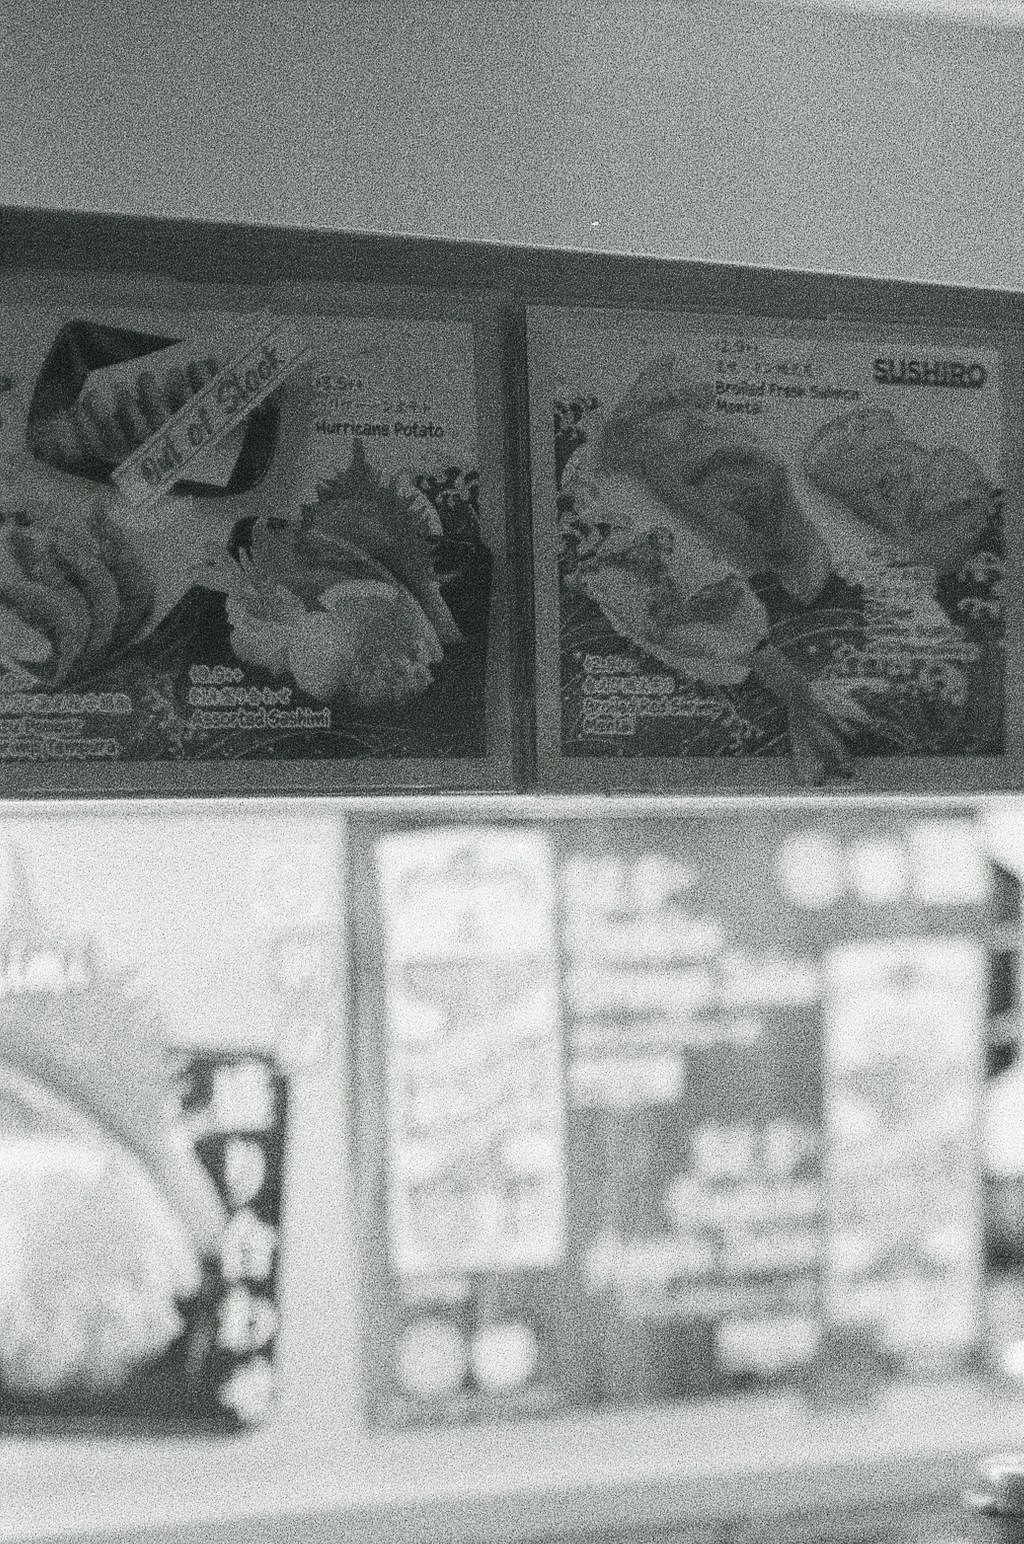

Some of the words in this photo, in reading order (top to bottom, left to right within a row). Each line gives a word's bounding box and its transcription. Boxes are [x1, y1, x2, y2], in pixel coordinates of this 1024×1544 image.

[216, 345, 285, 416] Stock
[873, 358, 987, 388] SUSHIRO
[315, 420, 390, 437] Hurricane
[393, 421, 445, 438] Potato
[192, 707, 266, 728] Assorted
[267, 706, 332, 729] Sashimi
